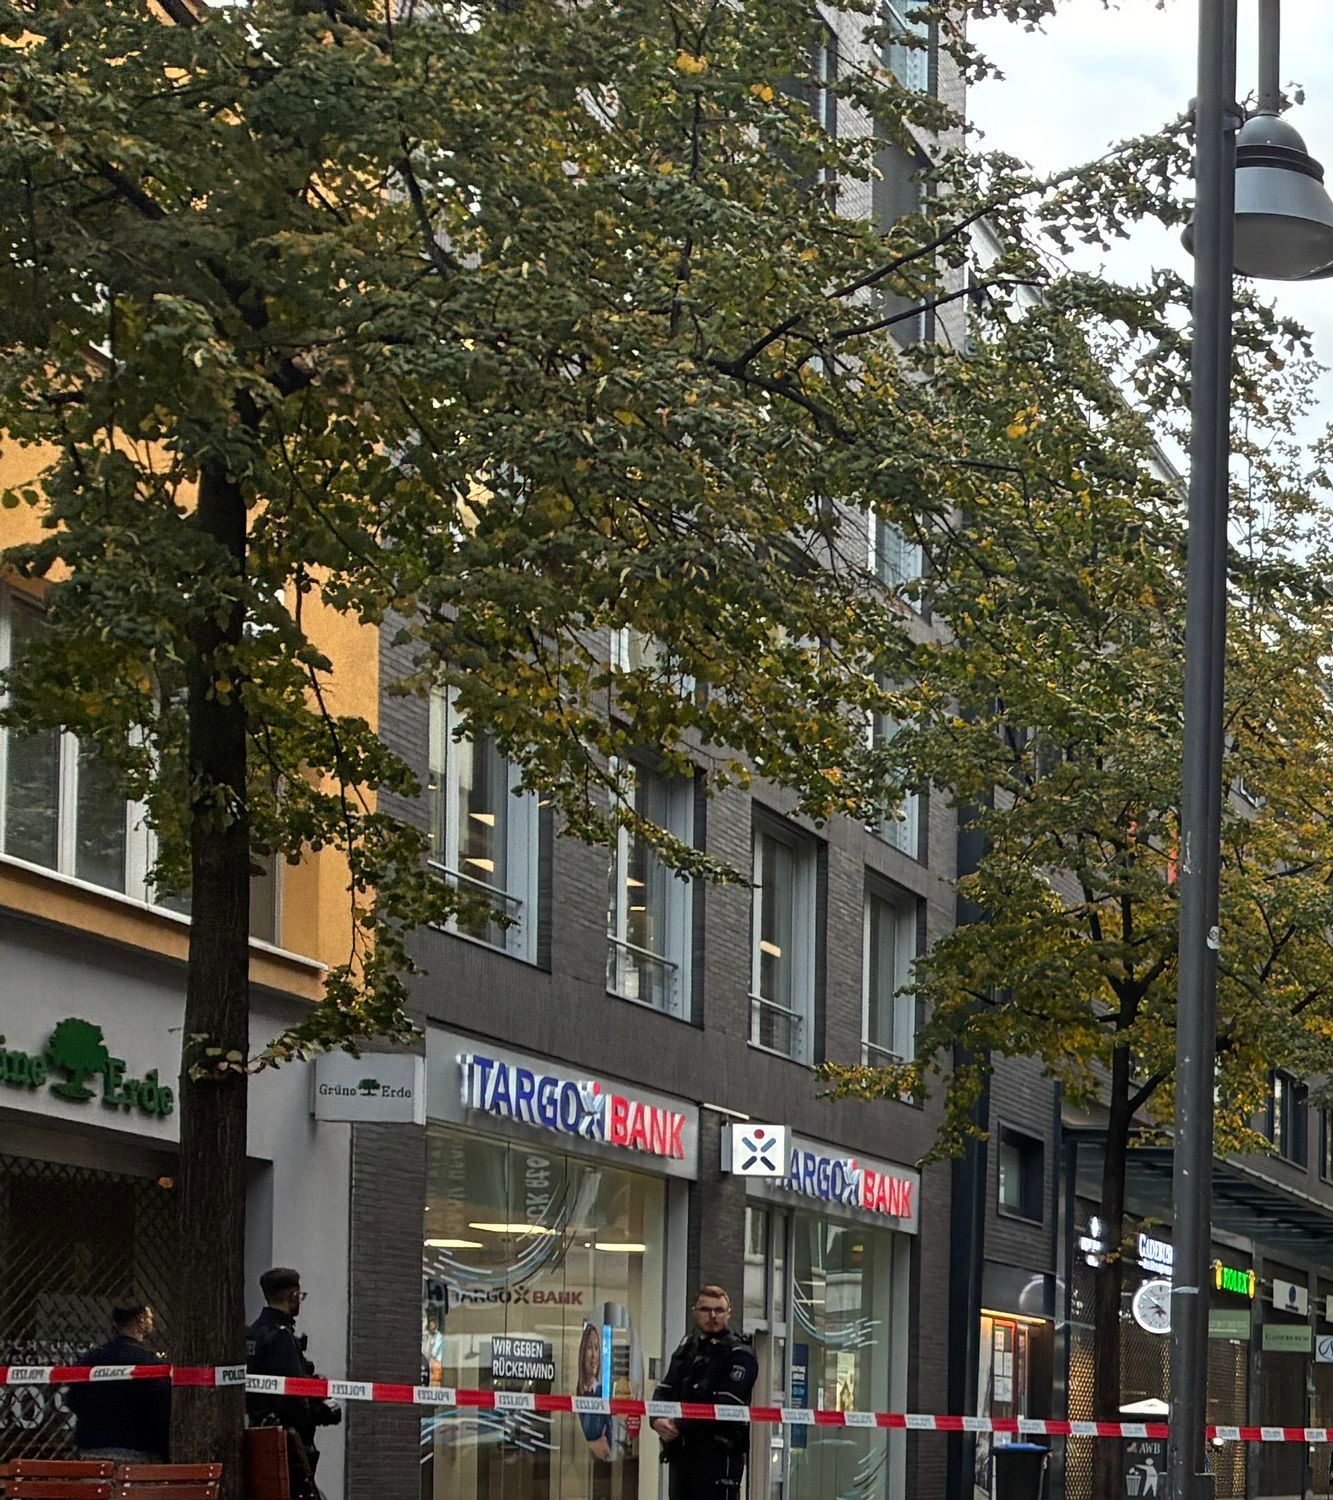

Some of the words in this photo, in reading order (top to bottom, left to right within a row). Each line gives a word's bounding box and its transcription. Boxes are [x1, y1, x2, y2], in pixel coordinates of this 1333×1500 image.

[102, 1057, 175, 1118] Erde
[318, 1083, 357, 1097] Grüne
[381, 1085, 412, 1098] Erde
[1223, 1266, 1249, 1295] ROLEX
[493, 1338, 512, 1357] WIR
[513, 1341, 543, 1359] GEBEN
[492, 1358, 555, 1381] RÜCKENWIND
[1138, 1443, 1161, 1454] AWB
